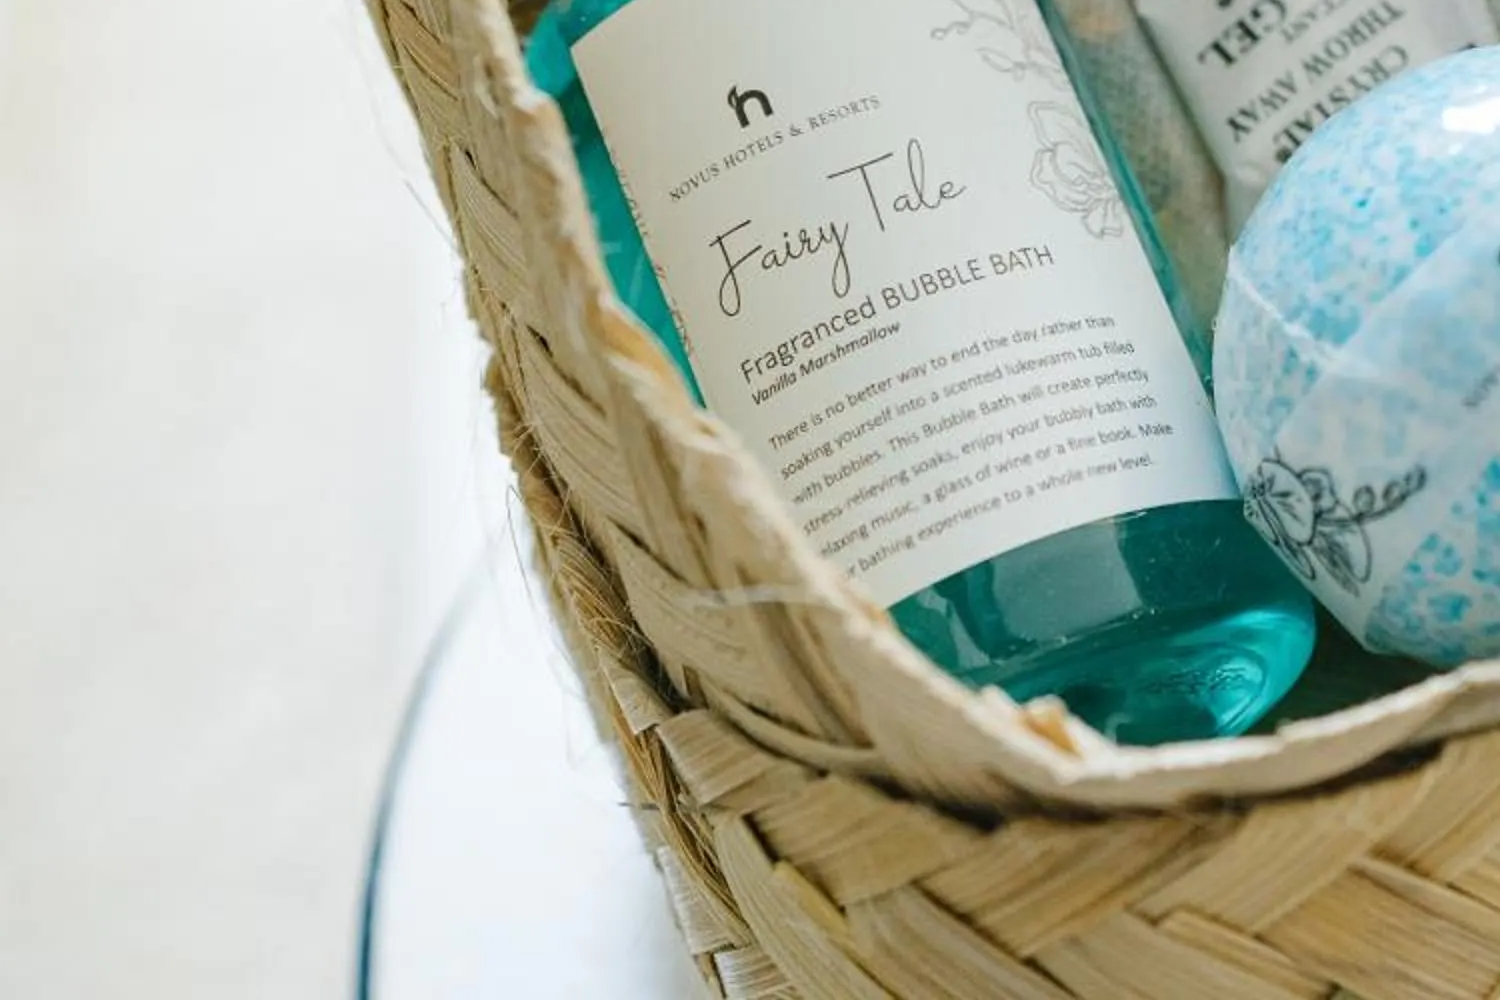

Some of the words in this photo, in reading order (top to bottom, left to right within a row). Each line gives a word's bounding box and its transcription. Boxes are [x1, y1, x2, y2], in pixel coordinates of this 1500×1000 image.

[668, 163, 721, 204] NOVUS
[723, 129, 785, 171] HOTELS
[788, 122, 805, 137] &
[808, 94, 883, 131] RESORTS
[1226, 69, 1298, 144] AWAY
[709, 218, 849, 318] Fairy
[826, 137, 968, 233] Tale
[740, 295, 878, 385] Fragranced
[881, 257, 987, 311] BUBBLE
[989, 243, 1056, 277] BATH
[751, 370, 798, 406] Vanilla
[800, 321, 902, 378] Marshmallow
[768, 419, 811, 451] There
[811, 411, 824, 428] is
[825, 400, 846, 419] no
[846, 376, 894, 408] better
[896, 362, 928, 386] way
[930, 354, 948, 371] to
[951, 341, 982, 363] end
[982, 334, 1010, 352] the
[1011, 327, 1039, 345] day
[1041, 317, 1083, 338] rather
[1084, 313, 1116, 330] than
[781, 438, 835, 481] soaking
[834, 405, 894, 450] yourself
[896, 395, 928, 417] into
[930, 390, 940, 404] a
[942, 364, 1003, 398] scented
[1004, 349, 1078, 376] lukewarm
[1078, 343, 1102, 360] tub
[889, 432, 921, 451] This
[922, 406, 977, 438] Bubble
[978, 393, 1017, 417] Bath
[1047, 377, 1092, 396] create
[961, 430, 1004, 456] enjoy
[1006, 417, 1041, 440] your
[1043, 404, 1094, 428] bubbly
[1095, 398, 1129, 416] bath
[858, 534, 916, 573] bathing
[916, 495, 1002, 541] experience
[1003, 488, 1023, 503] to
[1036, 468, 1084, 491] whole
[934, 475, 974, 503] glass
[975, 463, 992, 484] of
[995, 451, 1033, 475] wine
